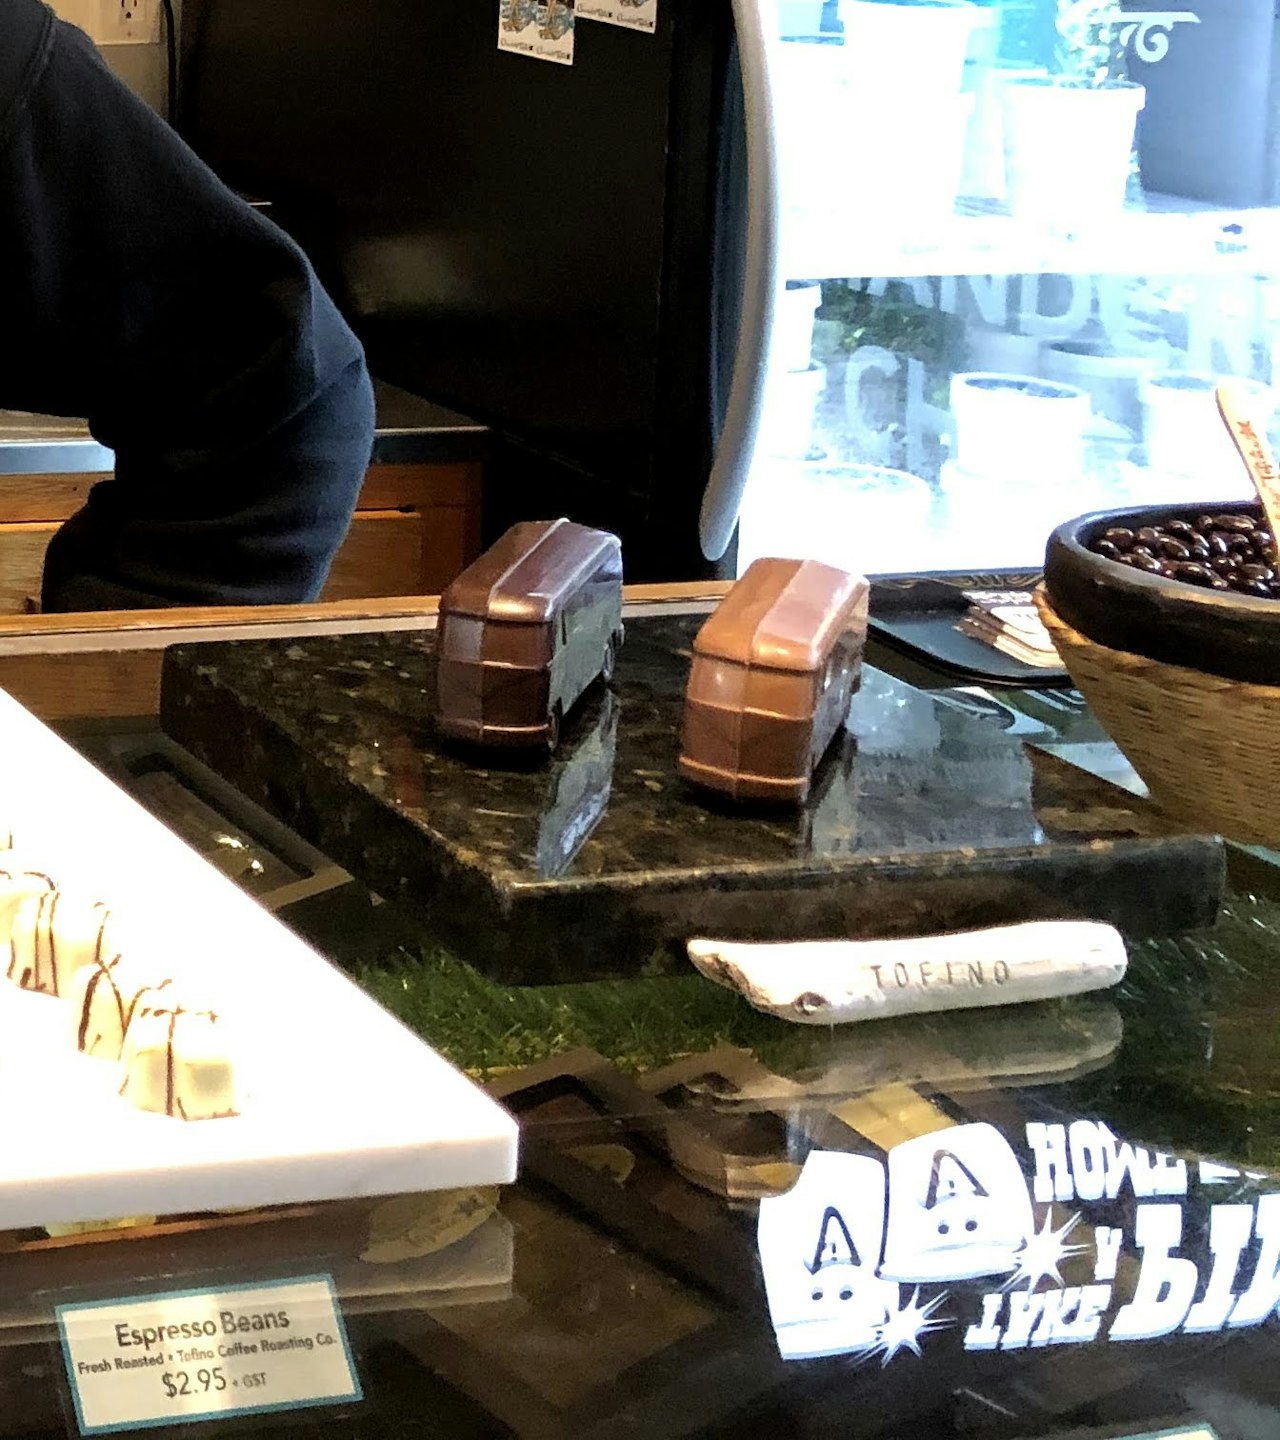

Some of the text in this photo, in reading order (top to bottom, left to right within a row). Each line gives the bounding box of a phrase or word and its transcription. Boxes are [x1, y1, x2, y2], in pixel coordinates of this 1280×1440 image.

[869, 959, 1011, 988] TOFINO
[115, 1311, 290, 1350] Espresso Beans
[78, 1332, 338, 1375] Fresh Roasted Tofino Coffee Roasting Co.
[161, 1366, 227, 1398] $2.95
[243, 1372, 268, 1388] GST
